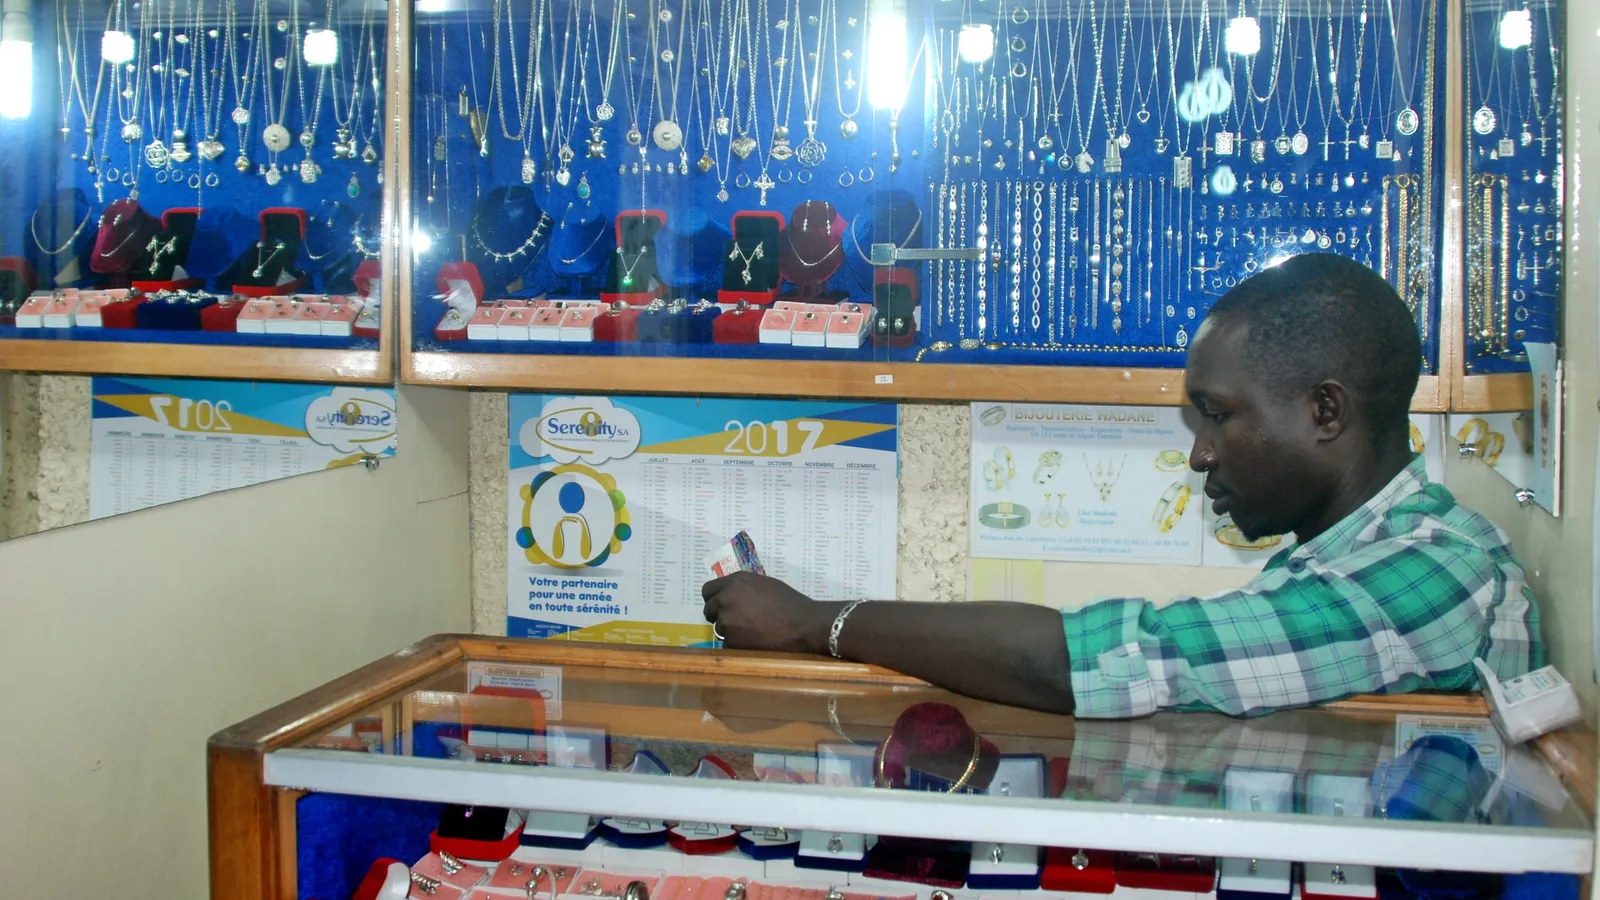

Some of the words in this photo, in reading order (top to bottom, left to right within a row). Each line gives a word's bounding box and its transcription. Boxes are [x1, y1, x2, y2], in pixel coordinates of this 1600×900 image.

[1014, 408, 1092, 421] BIJOUTERIE
[1096, 409, 1155, 422] WADANE
[547, 414, 617, 439] Serenity
[724, 419, 824, 454] 2017
[529, 577, 558, 587] Votre
[561, 579, 618, 589] partenaire
[529, 591, 554, 600] pour
[579, 592, 612, 601] année
[545, 602, 573, 612] toute
[576, 603, 620, 614] sérénité
